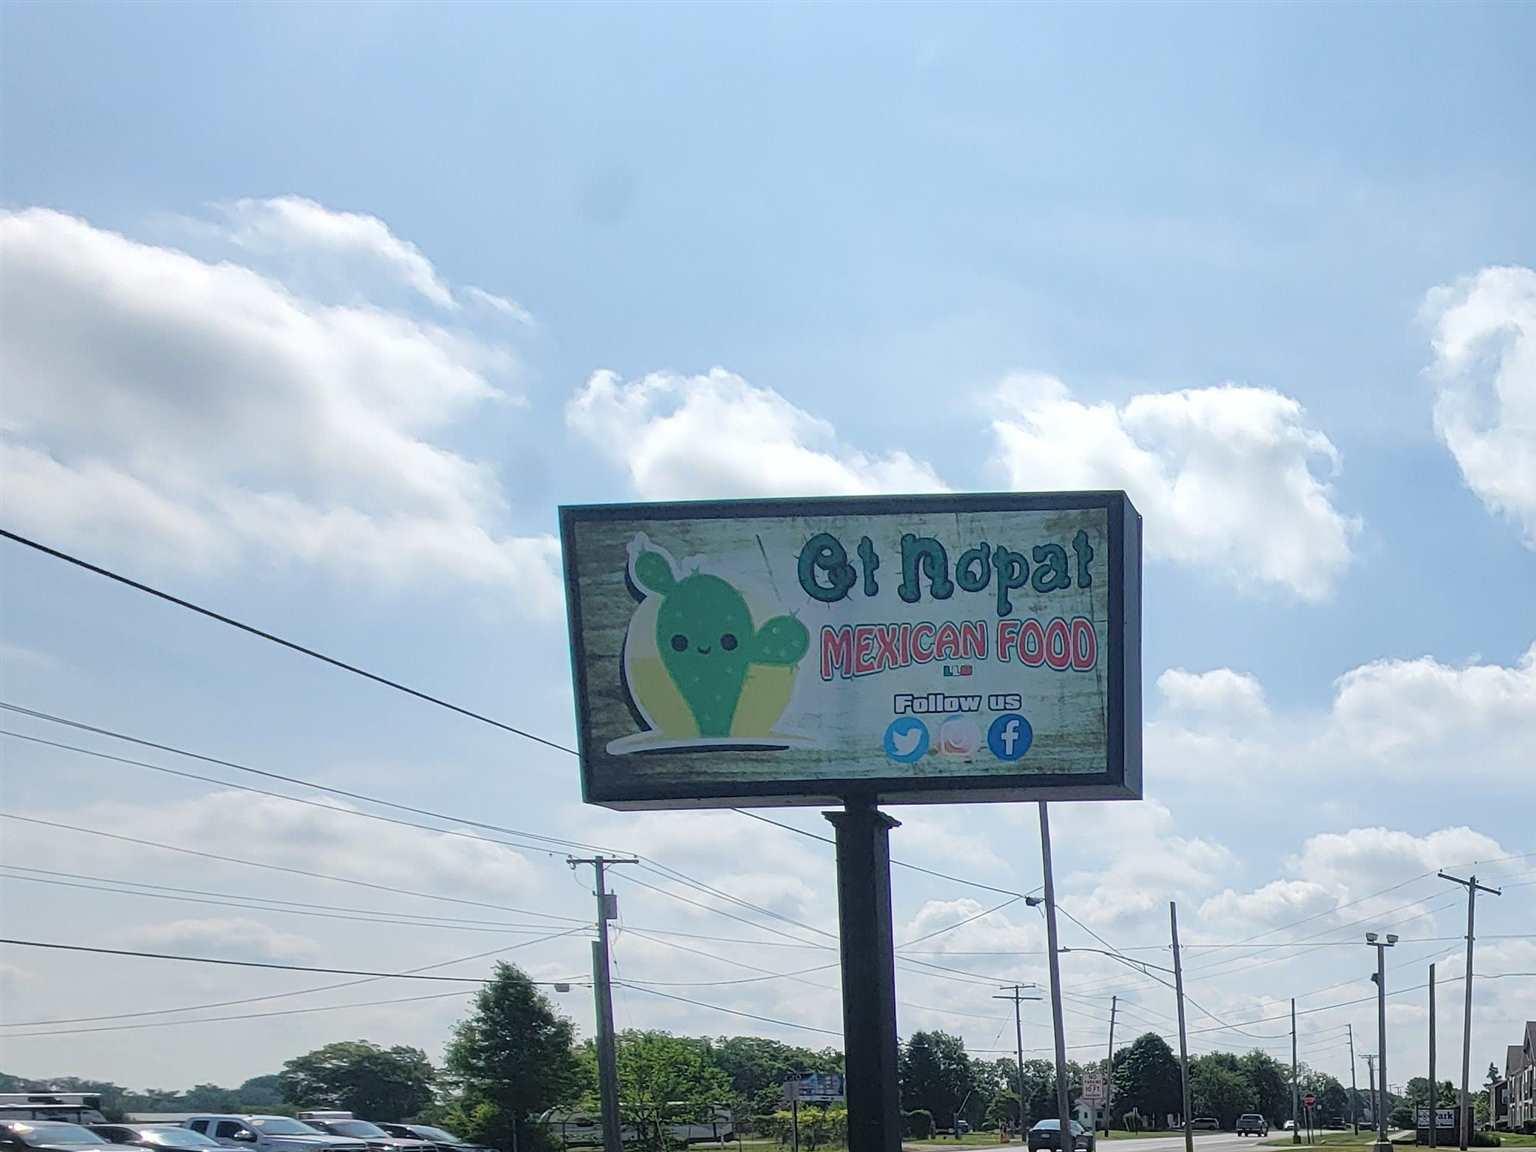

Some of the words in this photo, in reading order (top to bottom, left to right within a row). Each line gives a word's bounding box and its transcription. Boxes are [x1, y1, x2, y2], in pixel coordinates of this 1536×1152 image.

[820, 620, 988, 681] MEXICAN
[997, 616, 1098, 672] FOOD
[894, 693, 982, 714] Follow
[988, 694, 1022, 711] us
